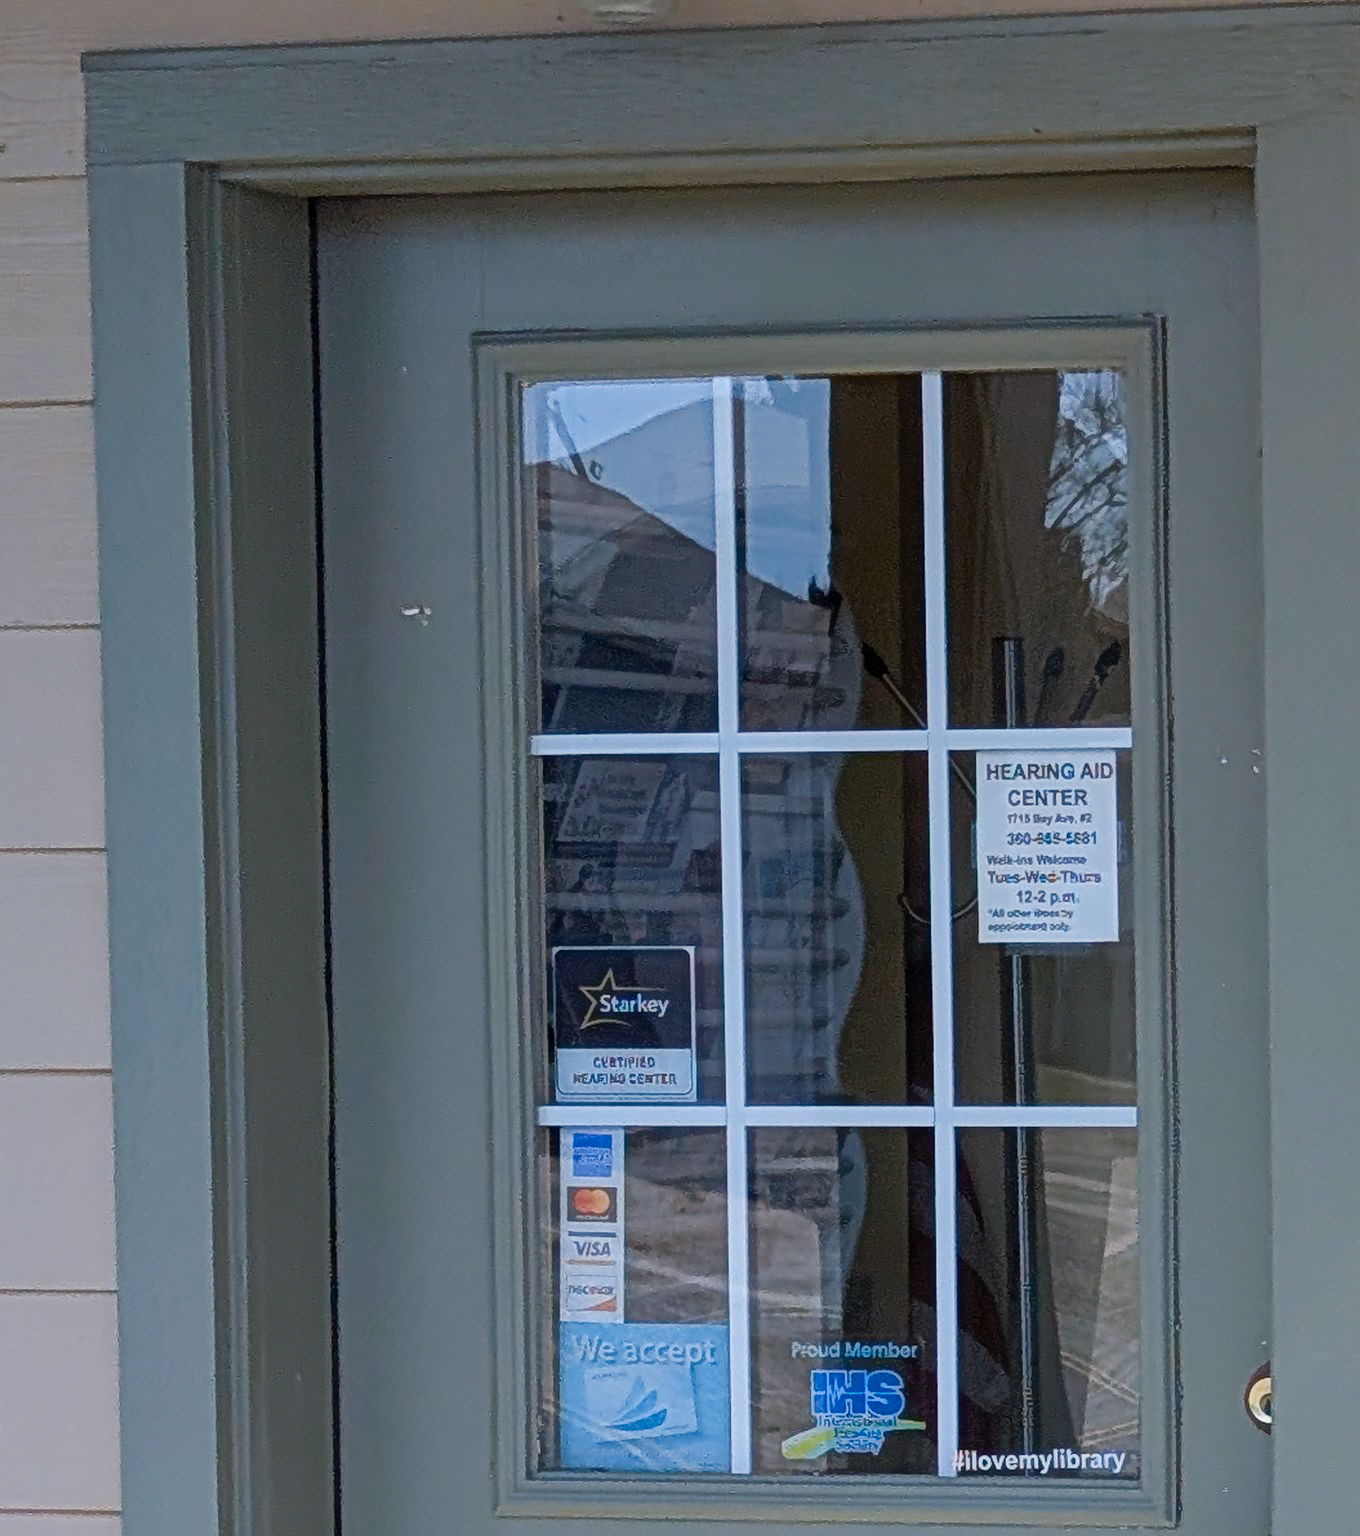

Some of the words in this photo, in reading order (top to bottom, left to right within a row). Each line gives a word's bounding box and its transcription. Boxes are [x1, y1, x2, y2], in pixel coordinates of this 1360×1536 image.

[986, 763, 1075, 780] HEARING
[1080, 762, 1113, 779] AID
[1008, 789, 1088, 806] CENTER
[1017, 890, 1046, 903] 12-2
[600, 993, 669, 1017] Starkey
[574, 1241, 611, 1256] VISA
[571, 1335, 617, 1362] We
[623, 1338, 716, 1369] accept
[791, 1341, 840, 1358] Proud
[845, 1341, 918, 1358] Member
[811, 1369, 905, 1418] IHS
[953, 1449, 1126, 1474] #ilovemylibrary
